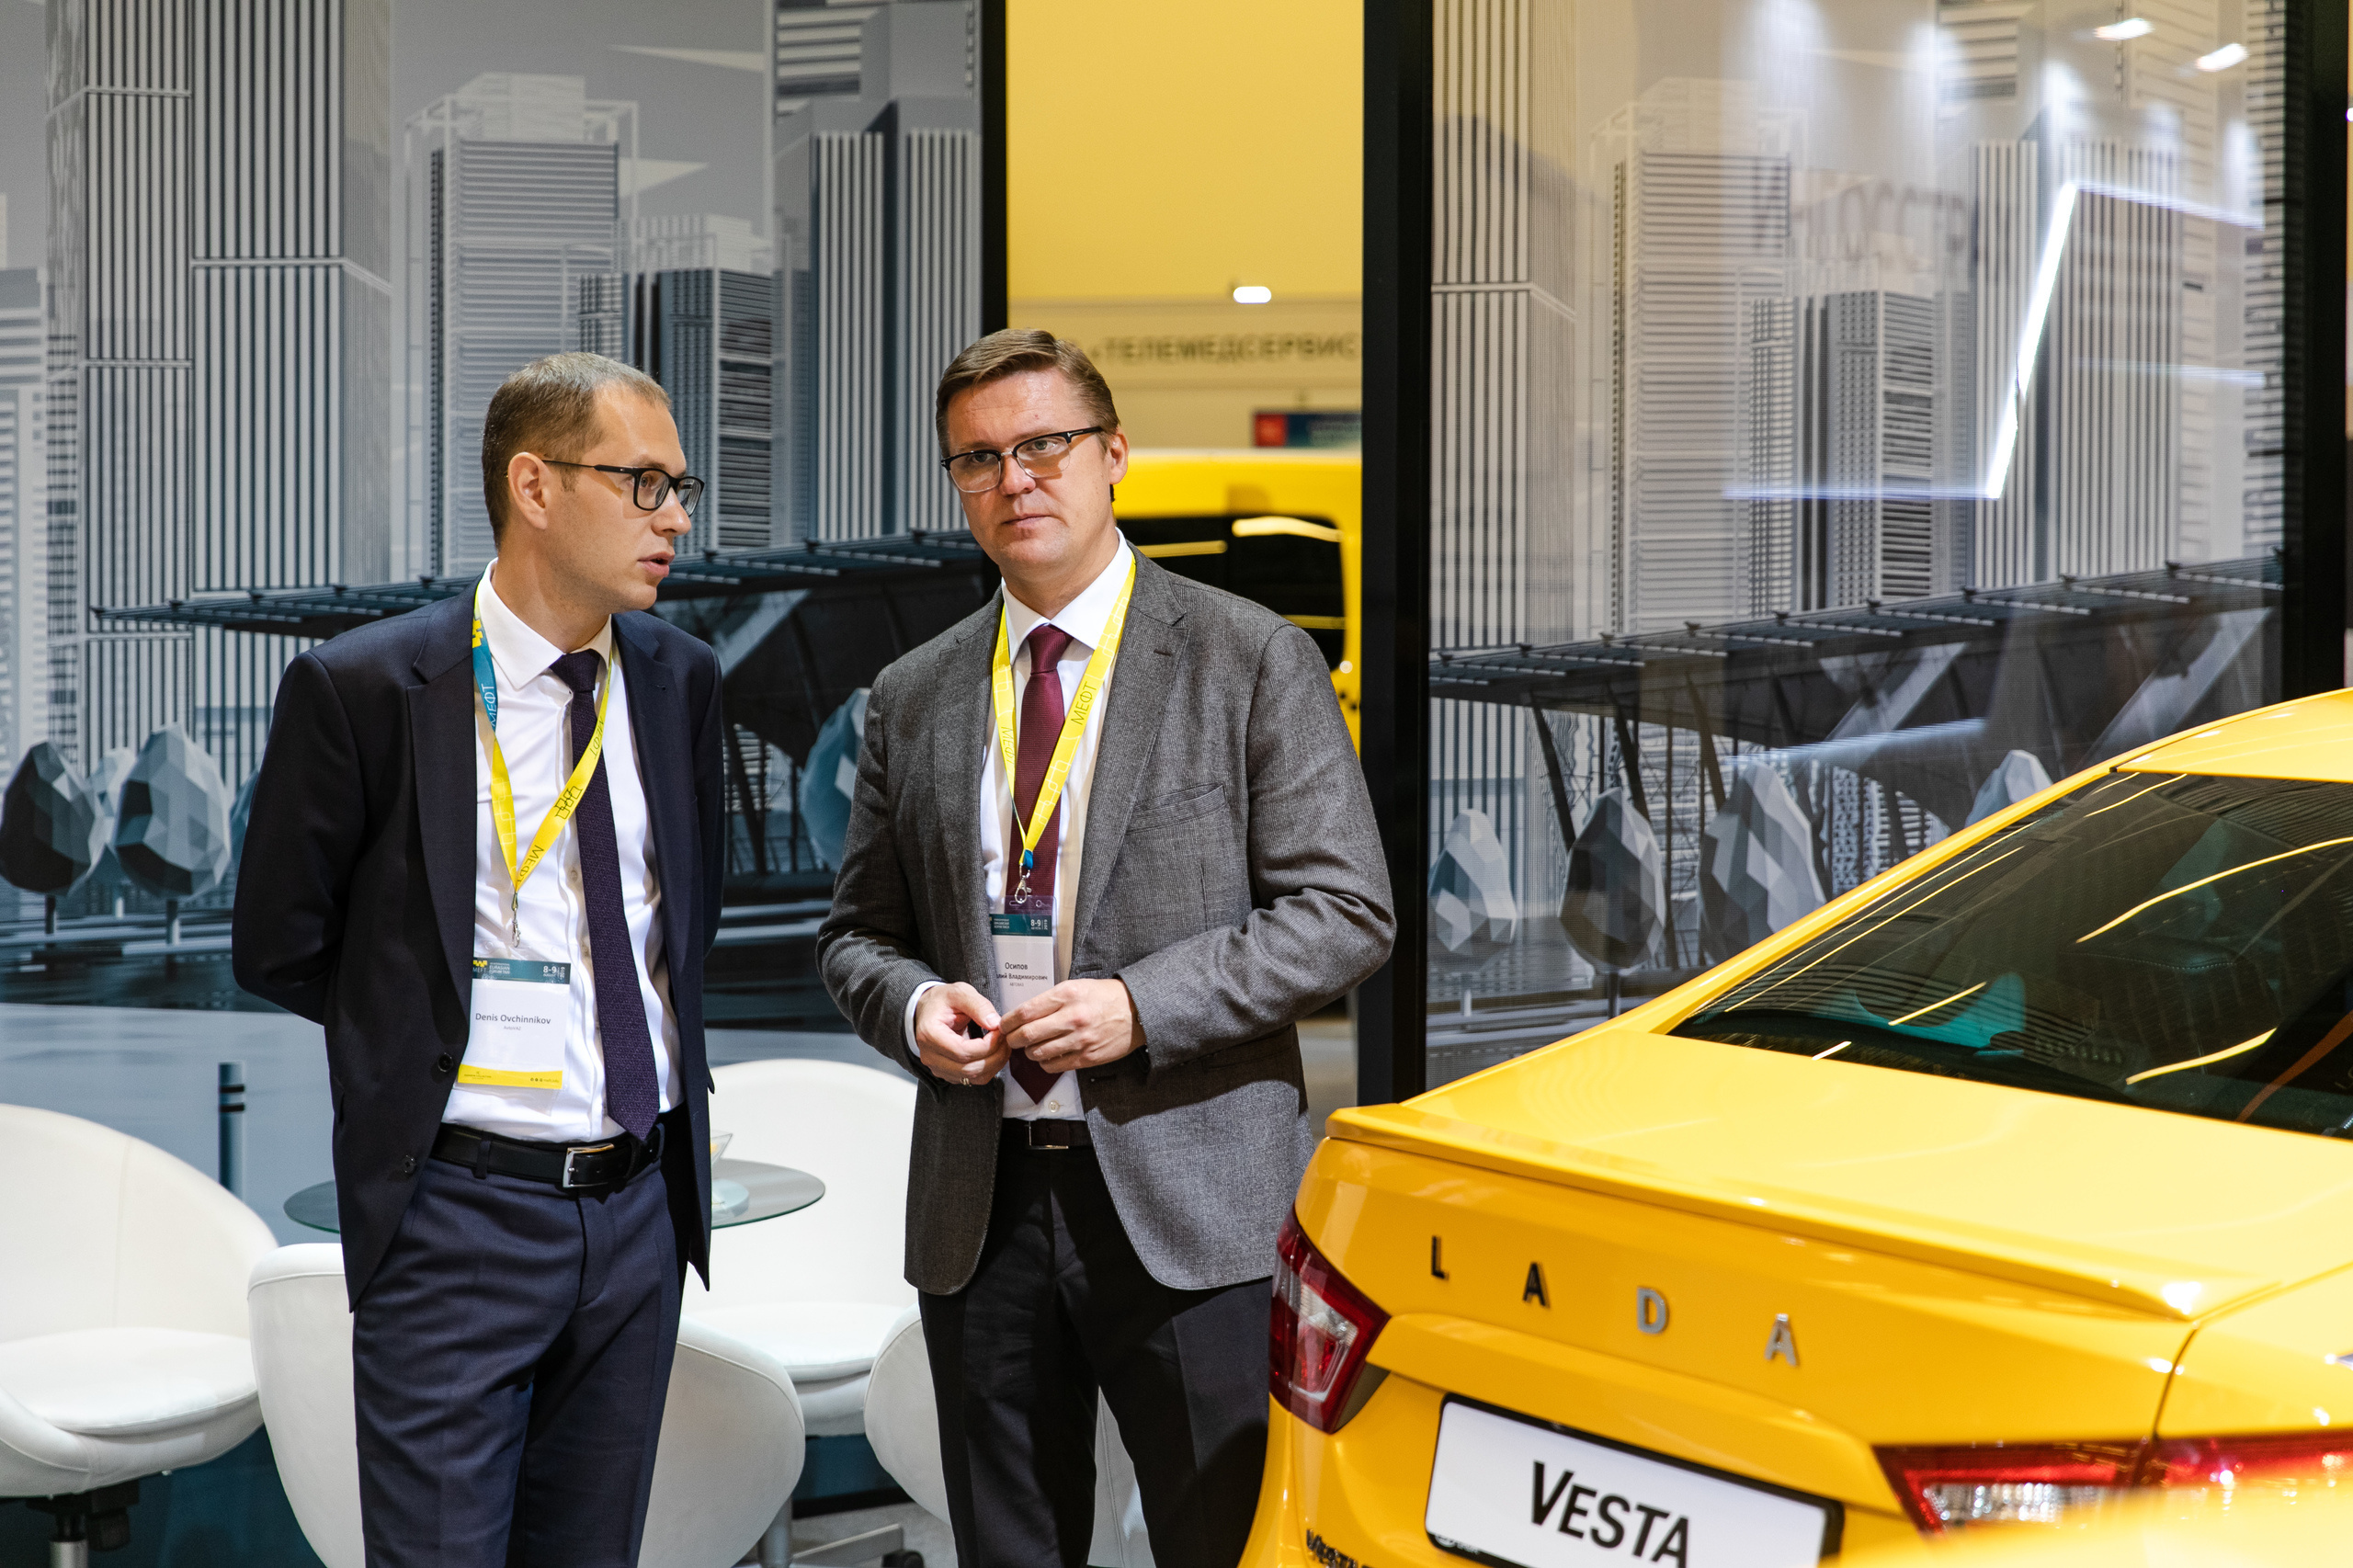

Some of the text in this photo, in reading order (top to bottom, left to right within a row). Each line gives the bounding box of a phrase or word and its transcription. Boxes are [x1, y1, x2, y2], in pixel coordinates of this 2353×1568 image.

[481, 683, 497, 727] МЕФТ
[1071, 681, 1097, 725] МЕФТ
[542, 965, 557, 973] 8-9
[475, 1013, 551, 1024] Denis Ovchinnikov
[1430, 1235, 1800, 1368] LADA
[1531, 1460, 1689, 1568] VESTA
